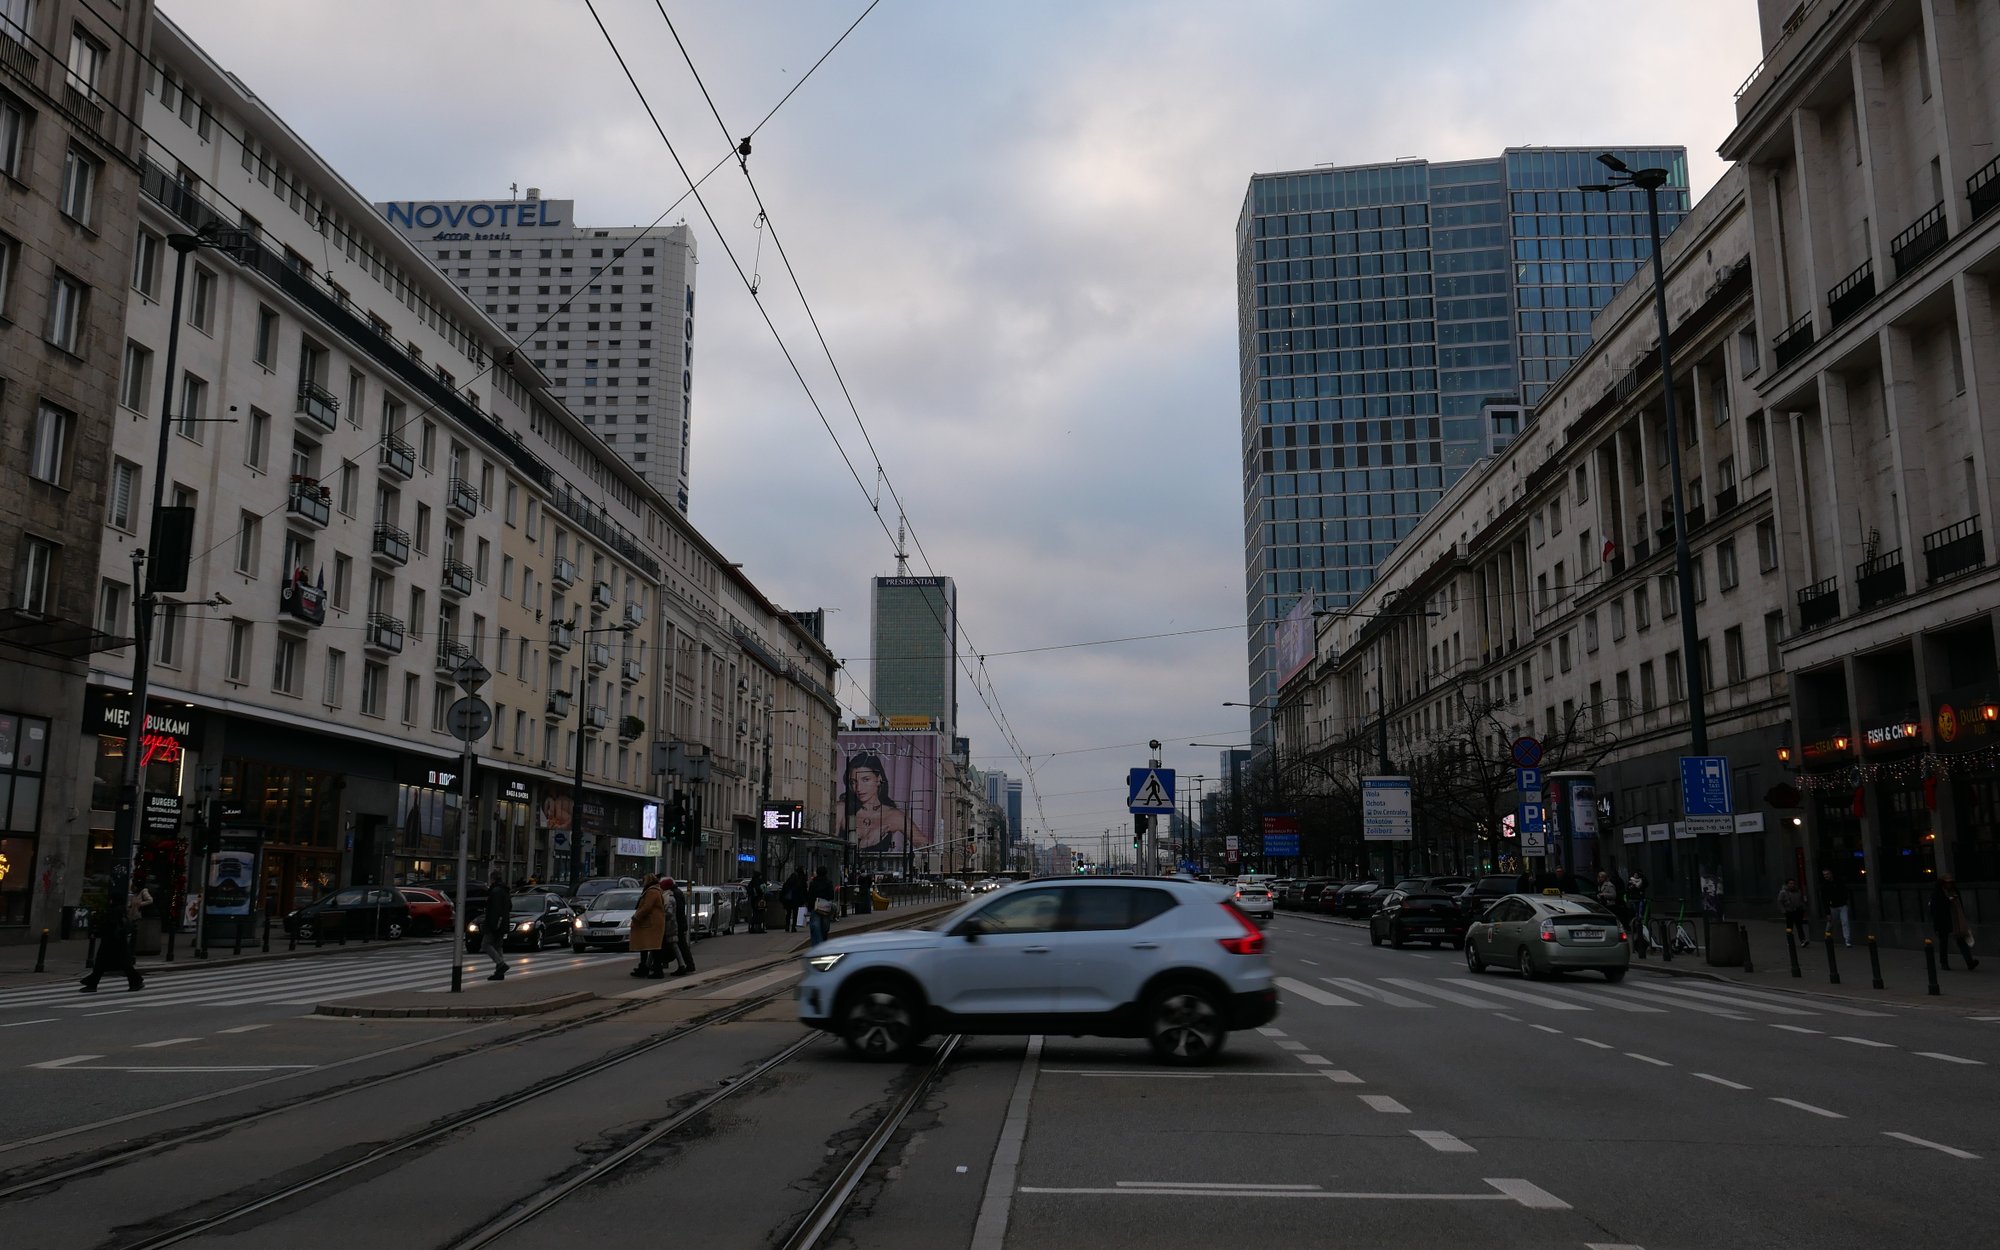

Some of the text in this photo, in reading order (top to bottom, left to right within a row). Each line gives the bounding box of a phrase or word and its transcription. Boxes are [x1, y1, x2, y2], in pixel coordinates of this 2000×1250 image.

[387, 200, 560, 229] NOVOTEL
[681, 284, 694, 477] NOVOTEL
[104, 707, 190, 736] MIĘD BUŁKAMI
[1867, 728, 1884, 744] FISH
[1884, 726, 1891, 741] &
[1522, 770, 1536, 788] P
[152, 797, 177, 807] BURGERS
[1524, 806, 1538, 824] P
